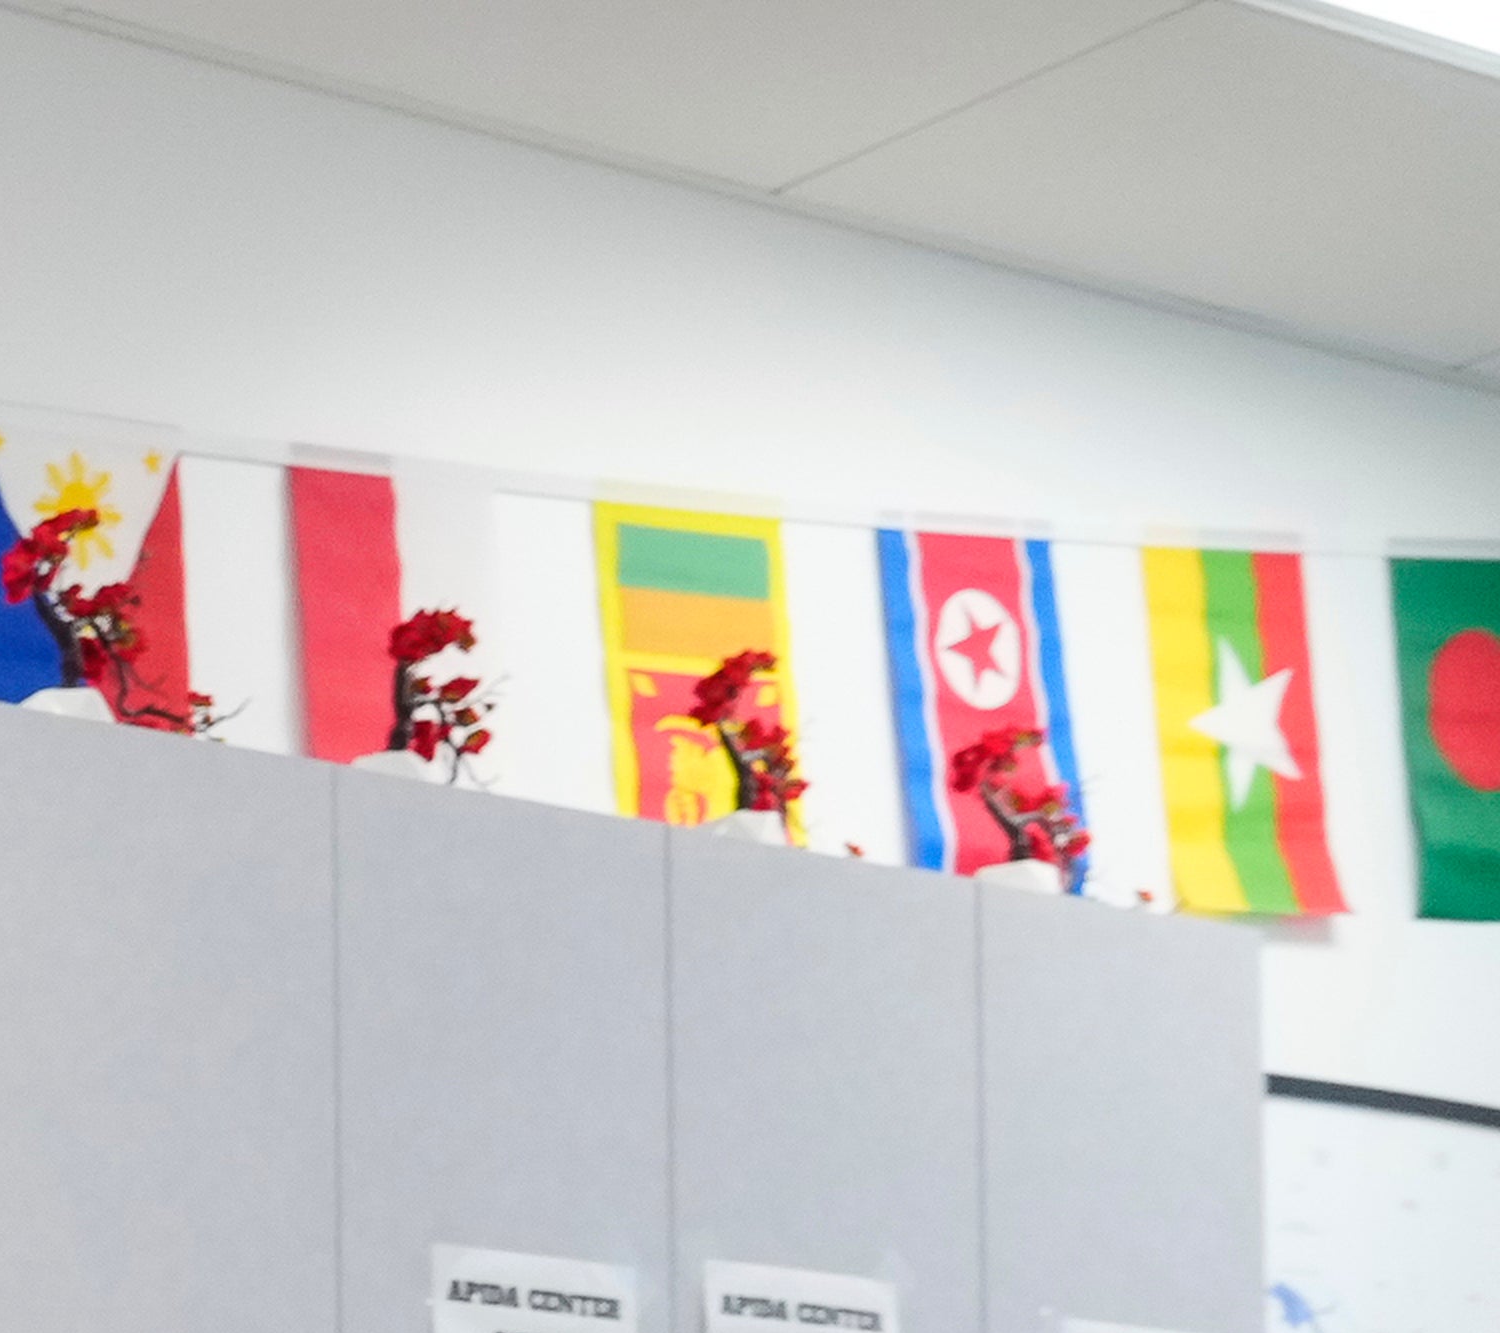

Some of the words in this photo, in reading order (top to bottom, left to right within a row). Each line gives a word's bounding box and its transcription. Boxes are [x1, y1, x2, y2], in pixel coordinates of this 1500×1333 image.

[448, 1279, 520, 1308] APIDA
[527, 1289, 621, 1320] CENTER
[721, 1294, 788, 1322] APIDA
[796, 1302, 884, 1333] CENTER
